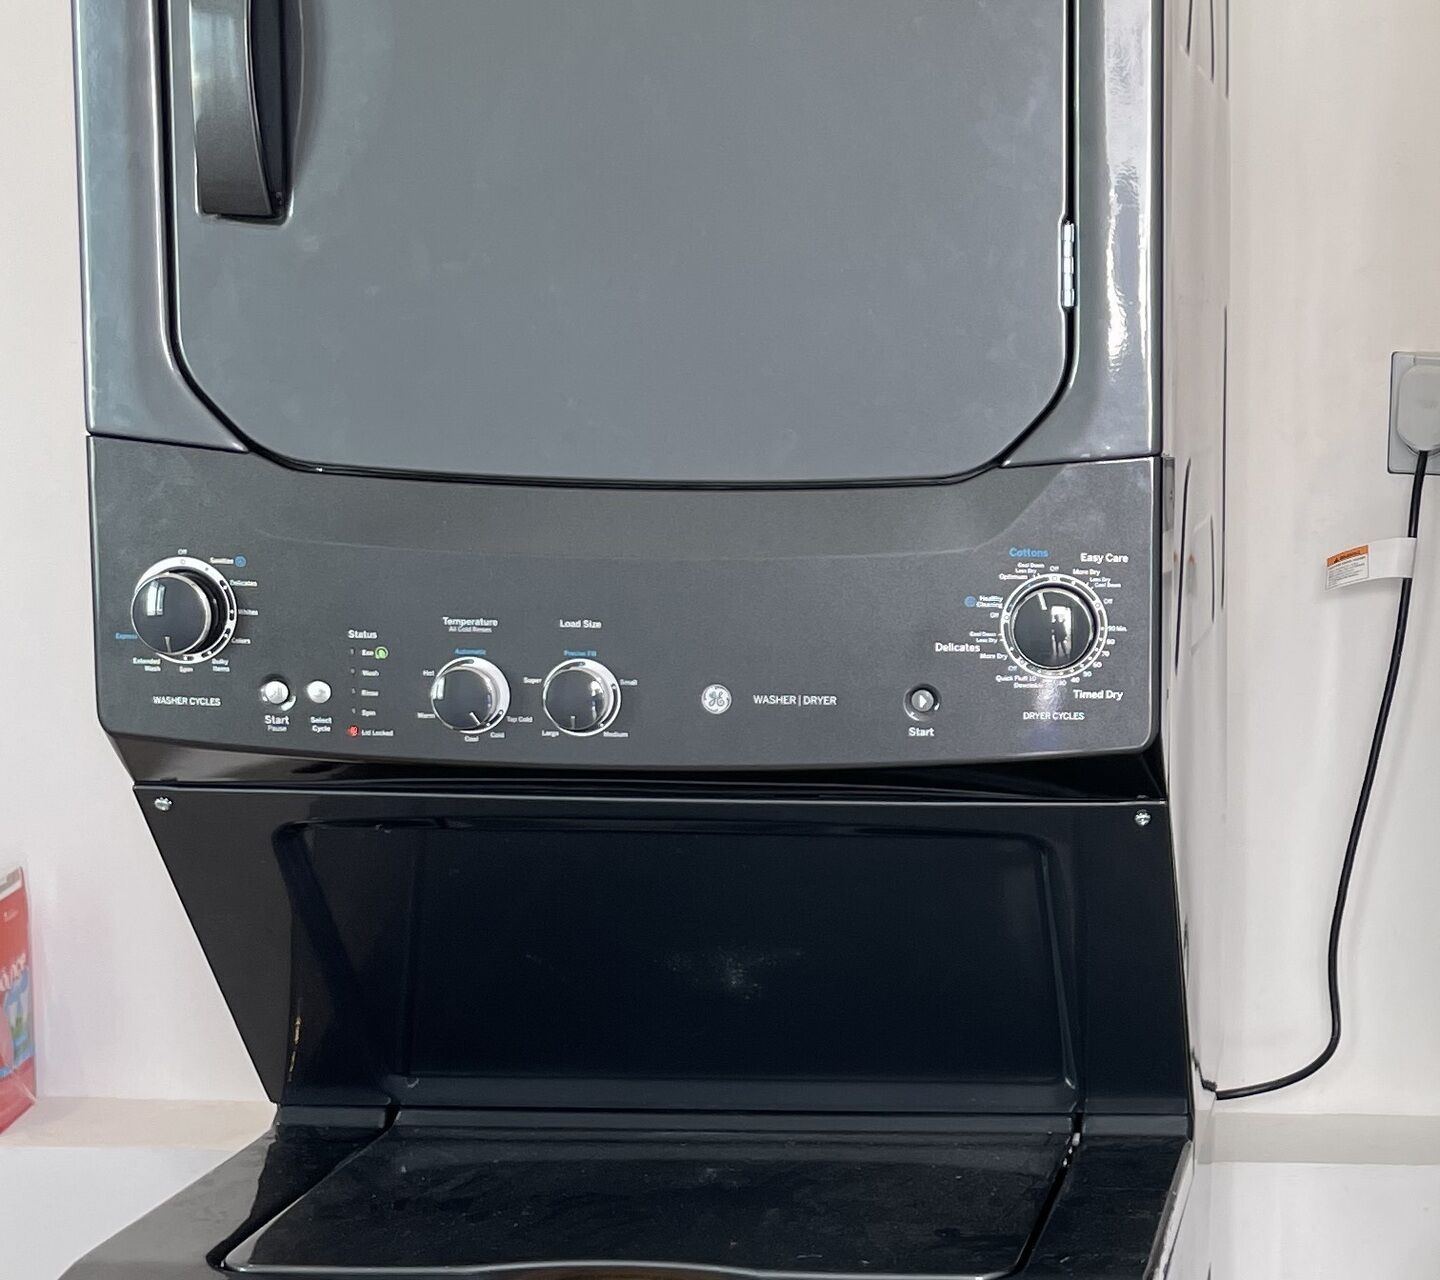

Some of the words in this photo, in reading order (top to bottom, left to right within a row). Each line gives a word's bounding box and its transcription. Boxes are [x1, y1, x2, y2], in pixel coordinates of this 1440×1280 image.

[1009, 548, 1048, 557] Cottons
[1080, 553, 1103, 564] Easy
[1106, 553, 1128, 563] Care
[443, 617, 498, 627] Temperature
[560, 620, 581, 628] Load
[582, 621, 601, 629] Size
[348, 630, 377, 639] Status
[935, 643, 980, 652] Delicates
[1073, 690, 1104, 699] Timed
[1106, 690, 1123, 700] Dry
[153, 696, 188, 705] WASHER
[189, 697, 221, 706] CYCLES
[753, 695, 796, 705] WASHER
[803, 696, 837, 705] DRYER
[265, 715, 289, 725] Start
[1023, 712, 1050, 720] DRYER
[1052, 712, 1085, 720] CYCLES
[908, 728, 934, 736] Start
